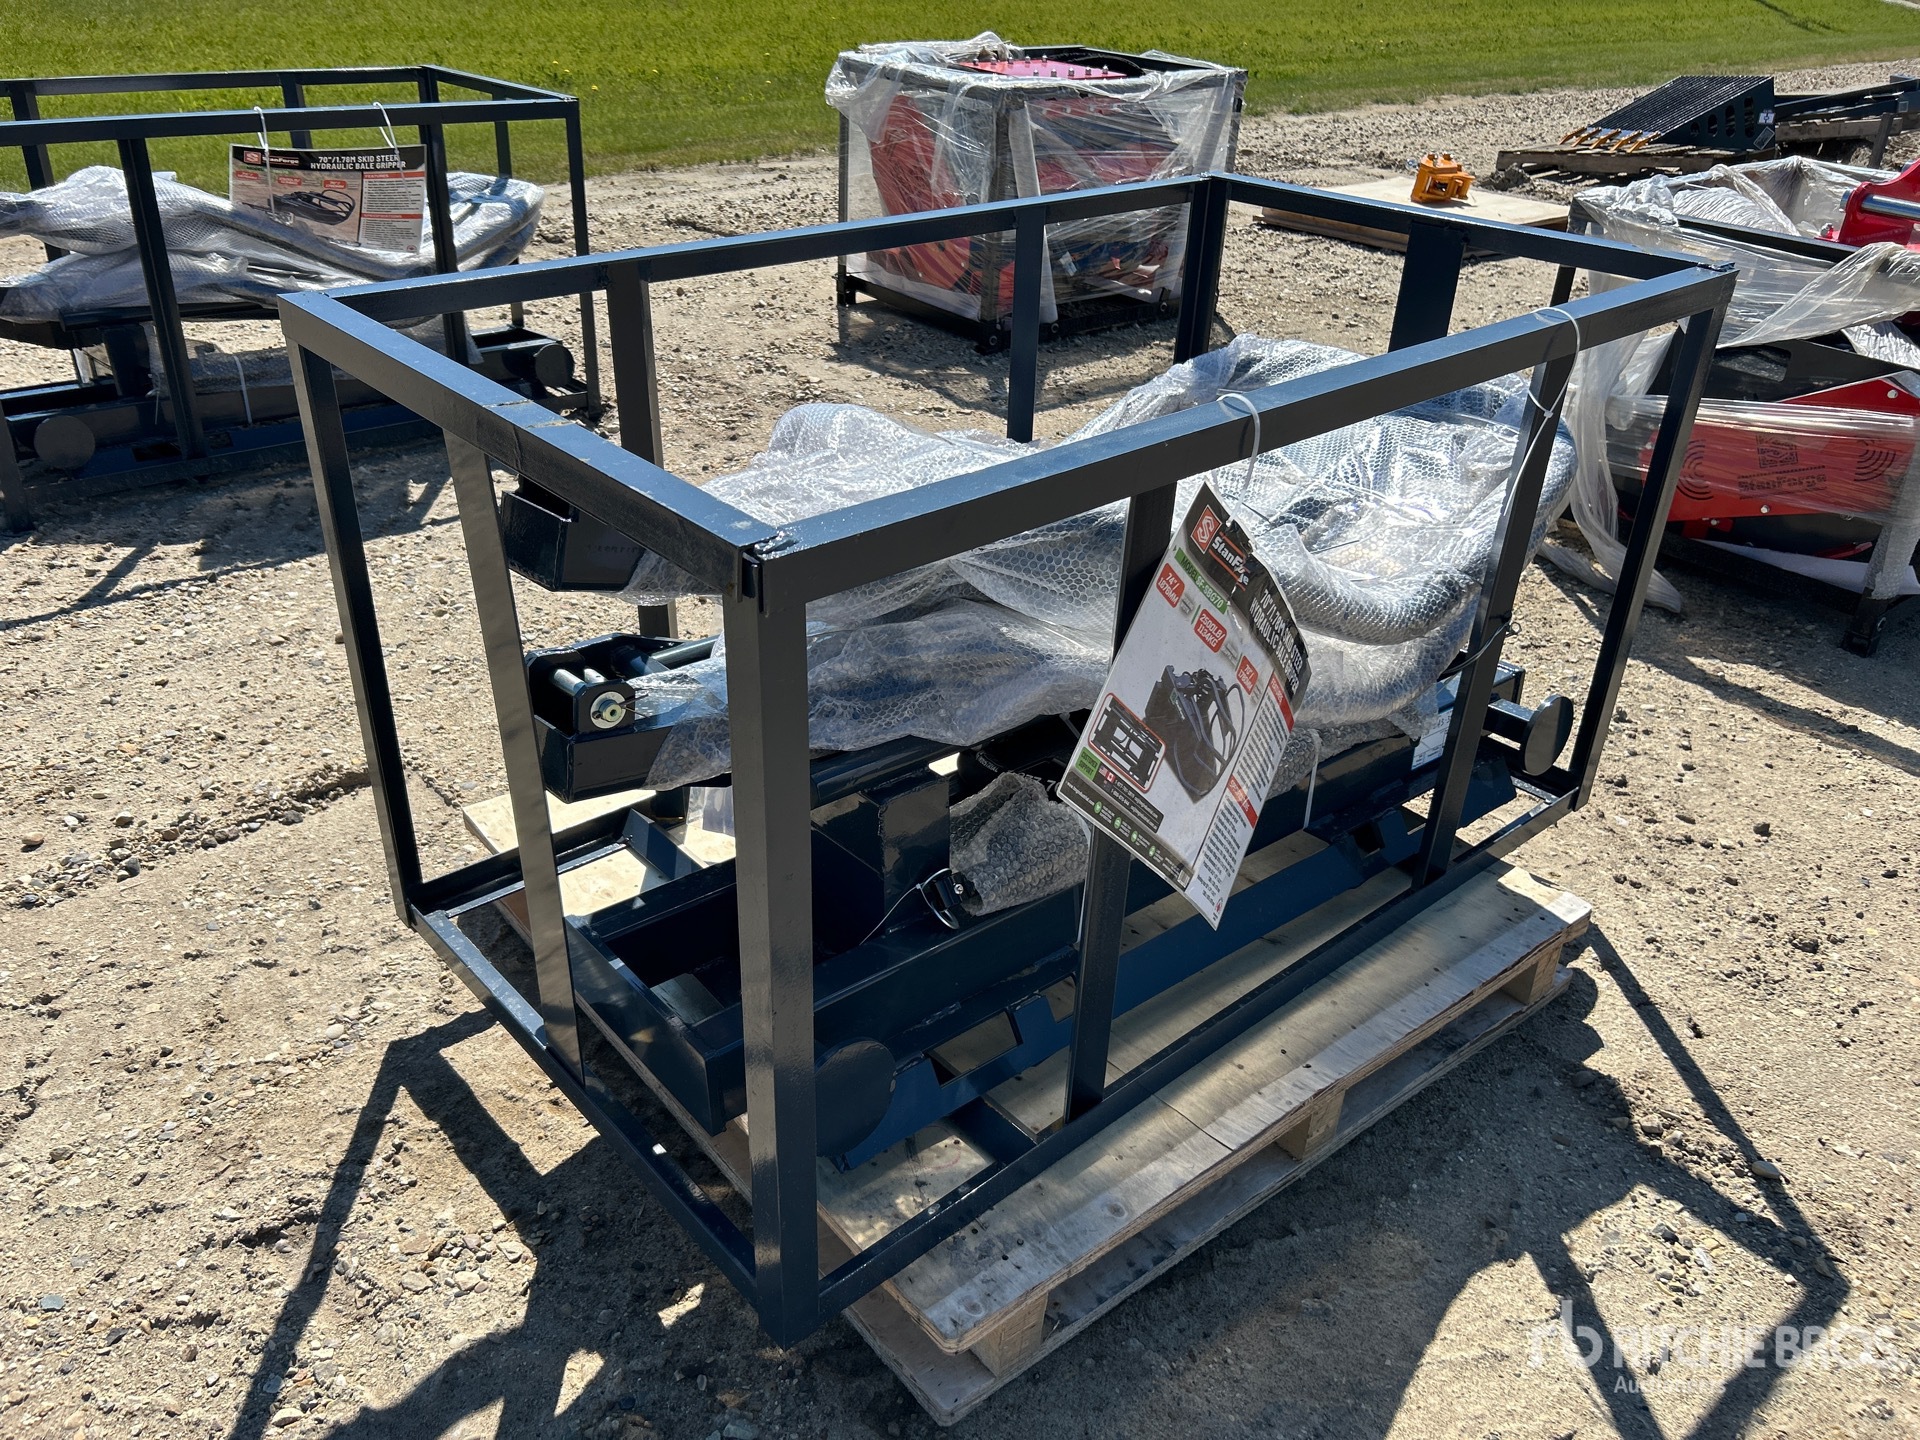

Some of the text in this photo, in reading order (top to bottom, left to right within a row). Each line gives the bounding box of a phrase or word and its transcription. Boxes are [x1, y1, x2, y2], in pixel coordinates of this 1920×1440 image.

[262, 155, 300, 164] SanForge
[310, 162, 354, 170] HYDRAULIC
[355, 162, 375, 170] BALE
[1212, 536, 1250, 586] StanFoge
[1179, 556, 1199, 580] MODEL
[1195, 575, 1224, 608] SF-SBG70
[1197, 625, 1219, 648] 1134KG
[1199, 613, 1226, 640] 2500LB/
[1249, 597, 1280, 650] HYDRAULIC
[1275, 640, 1289, 669] BALE
[1283, 627, 1295, 653] SKID
[1078, 762, 1094, 776] SUPPORT
[1080, 750, 1098, 768] CUSTOMER
